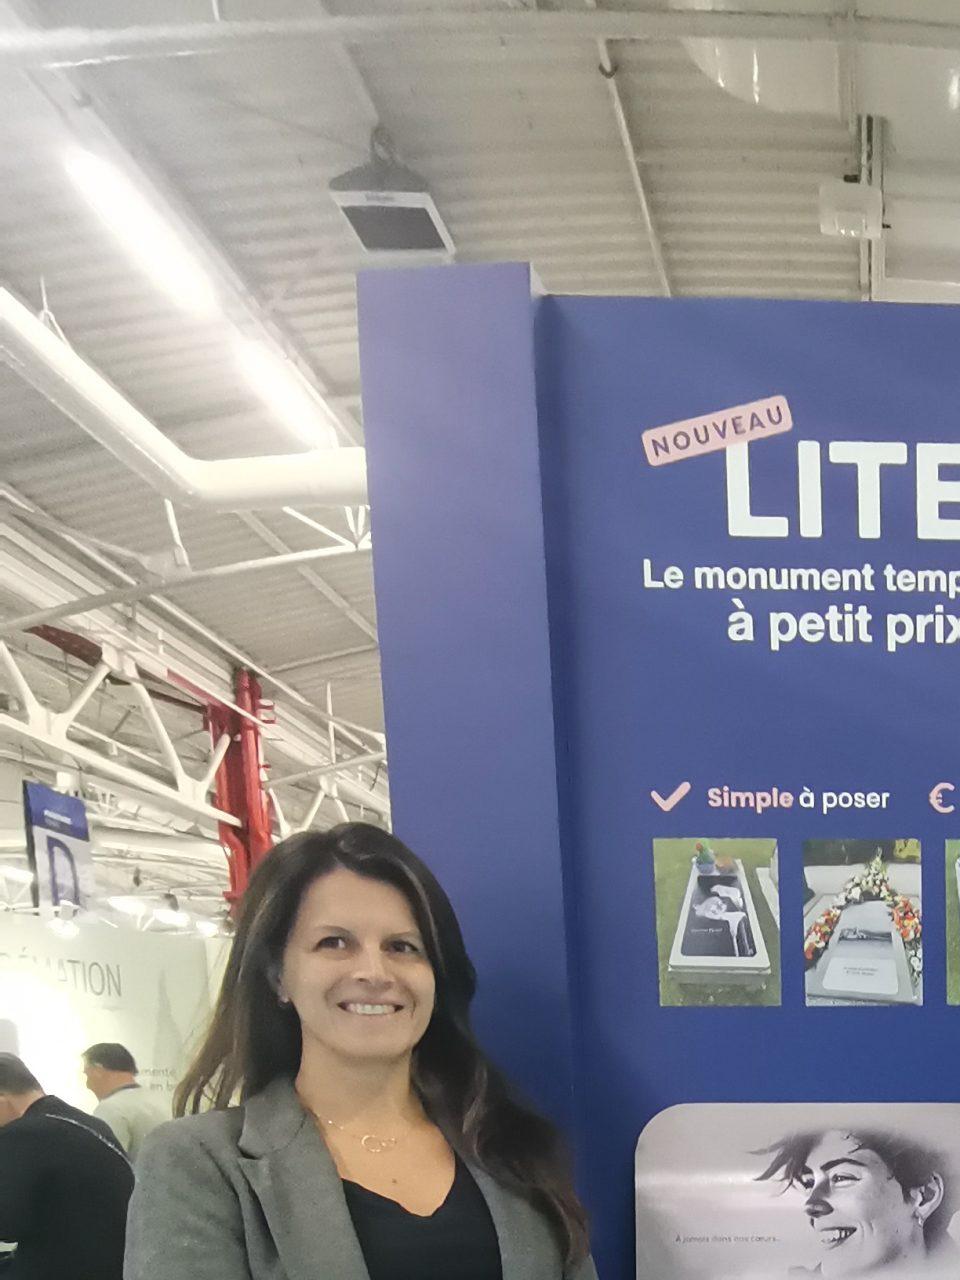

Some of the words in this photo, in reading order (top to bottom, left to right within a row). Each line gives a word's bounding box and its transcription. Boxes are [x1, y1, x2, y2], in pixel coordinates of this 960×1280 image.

[651, 405, 783, 457] NOUVEAU
[643, 558, 684, 589] Le
[694, 563, 875, 592] monument
[727, 598, 754, 642] à
[769, 603, 873, 651] petit
[707, 786, 794, 814] Simple
[799, 786, 815, 808] à
[822, 790, 890, 814] poser
